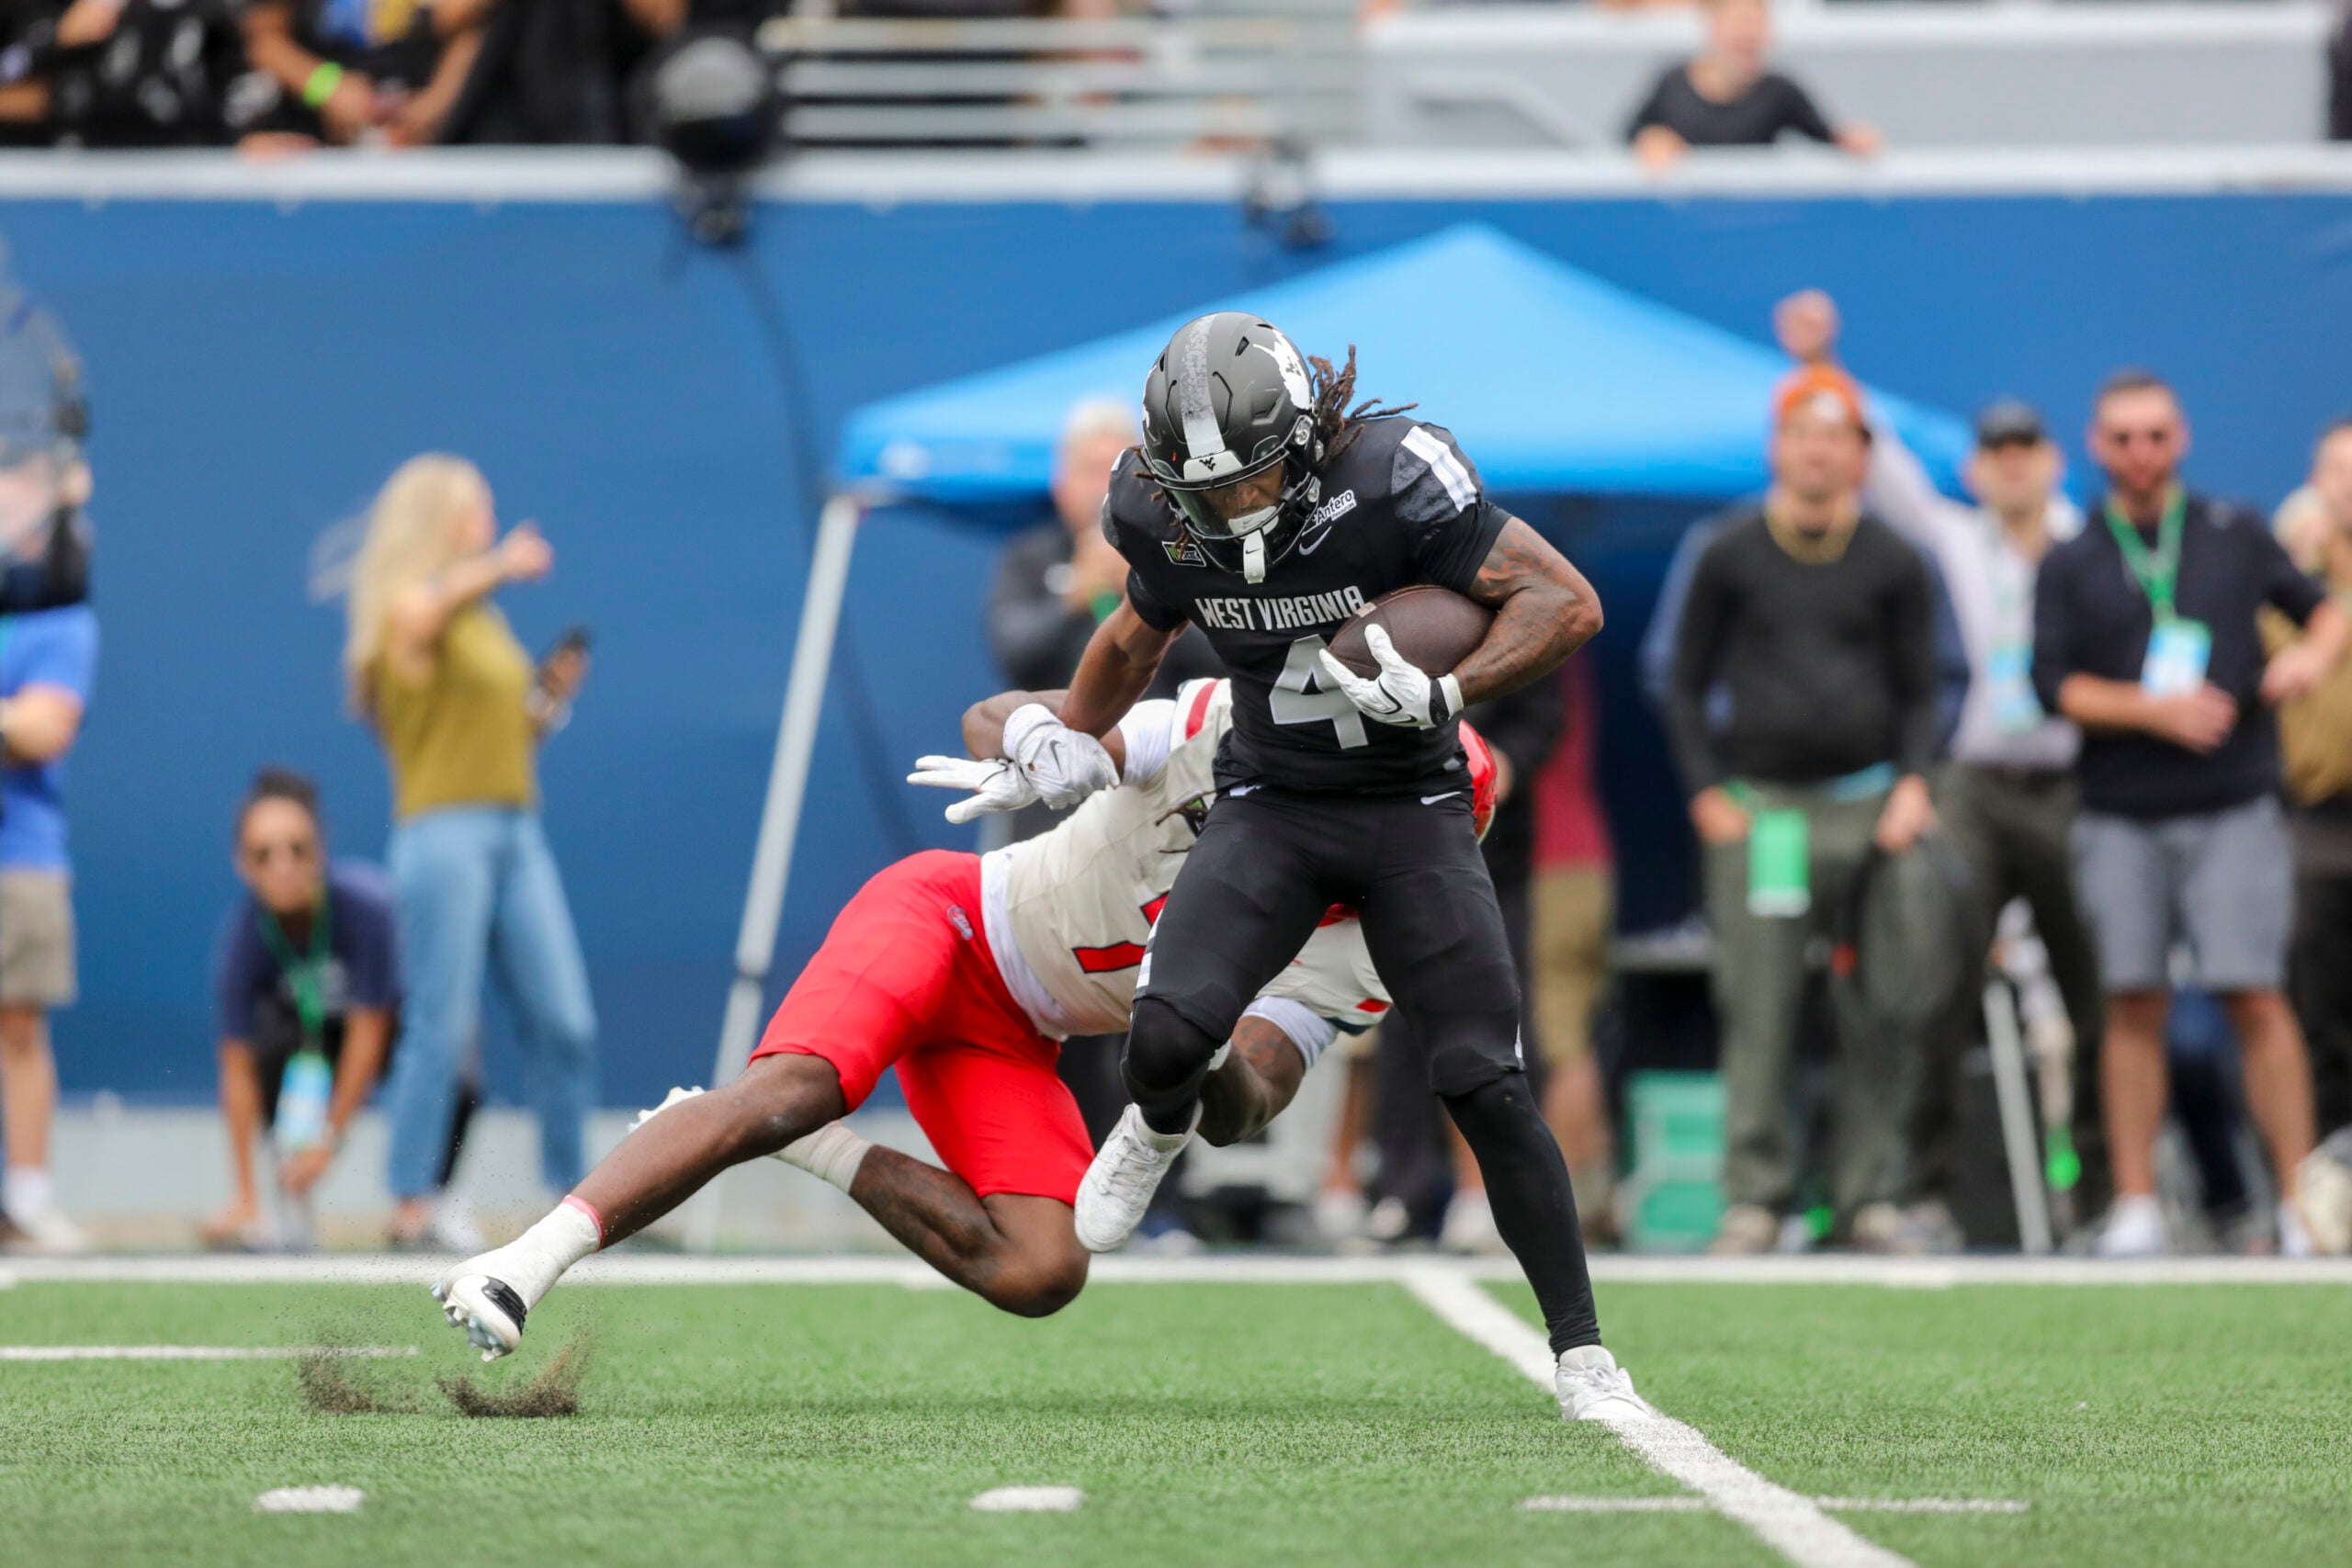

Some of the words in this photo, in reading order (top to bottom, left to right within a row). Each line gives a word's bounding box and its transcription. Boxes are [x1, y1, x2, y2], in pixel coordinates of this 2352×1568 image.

[1316, 491, 1352, 522] Antero
[1194, 598, 1255, 630] WEST
[1256, 585, 1365, 630] VIRGINIA
[1269, 634, 1369, 750] 4
